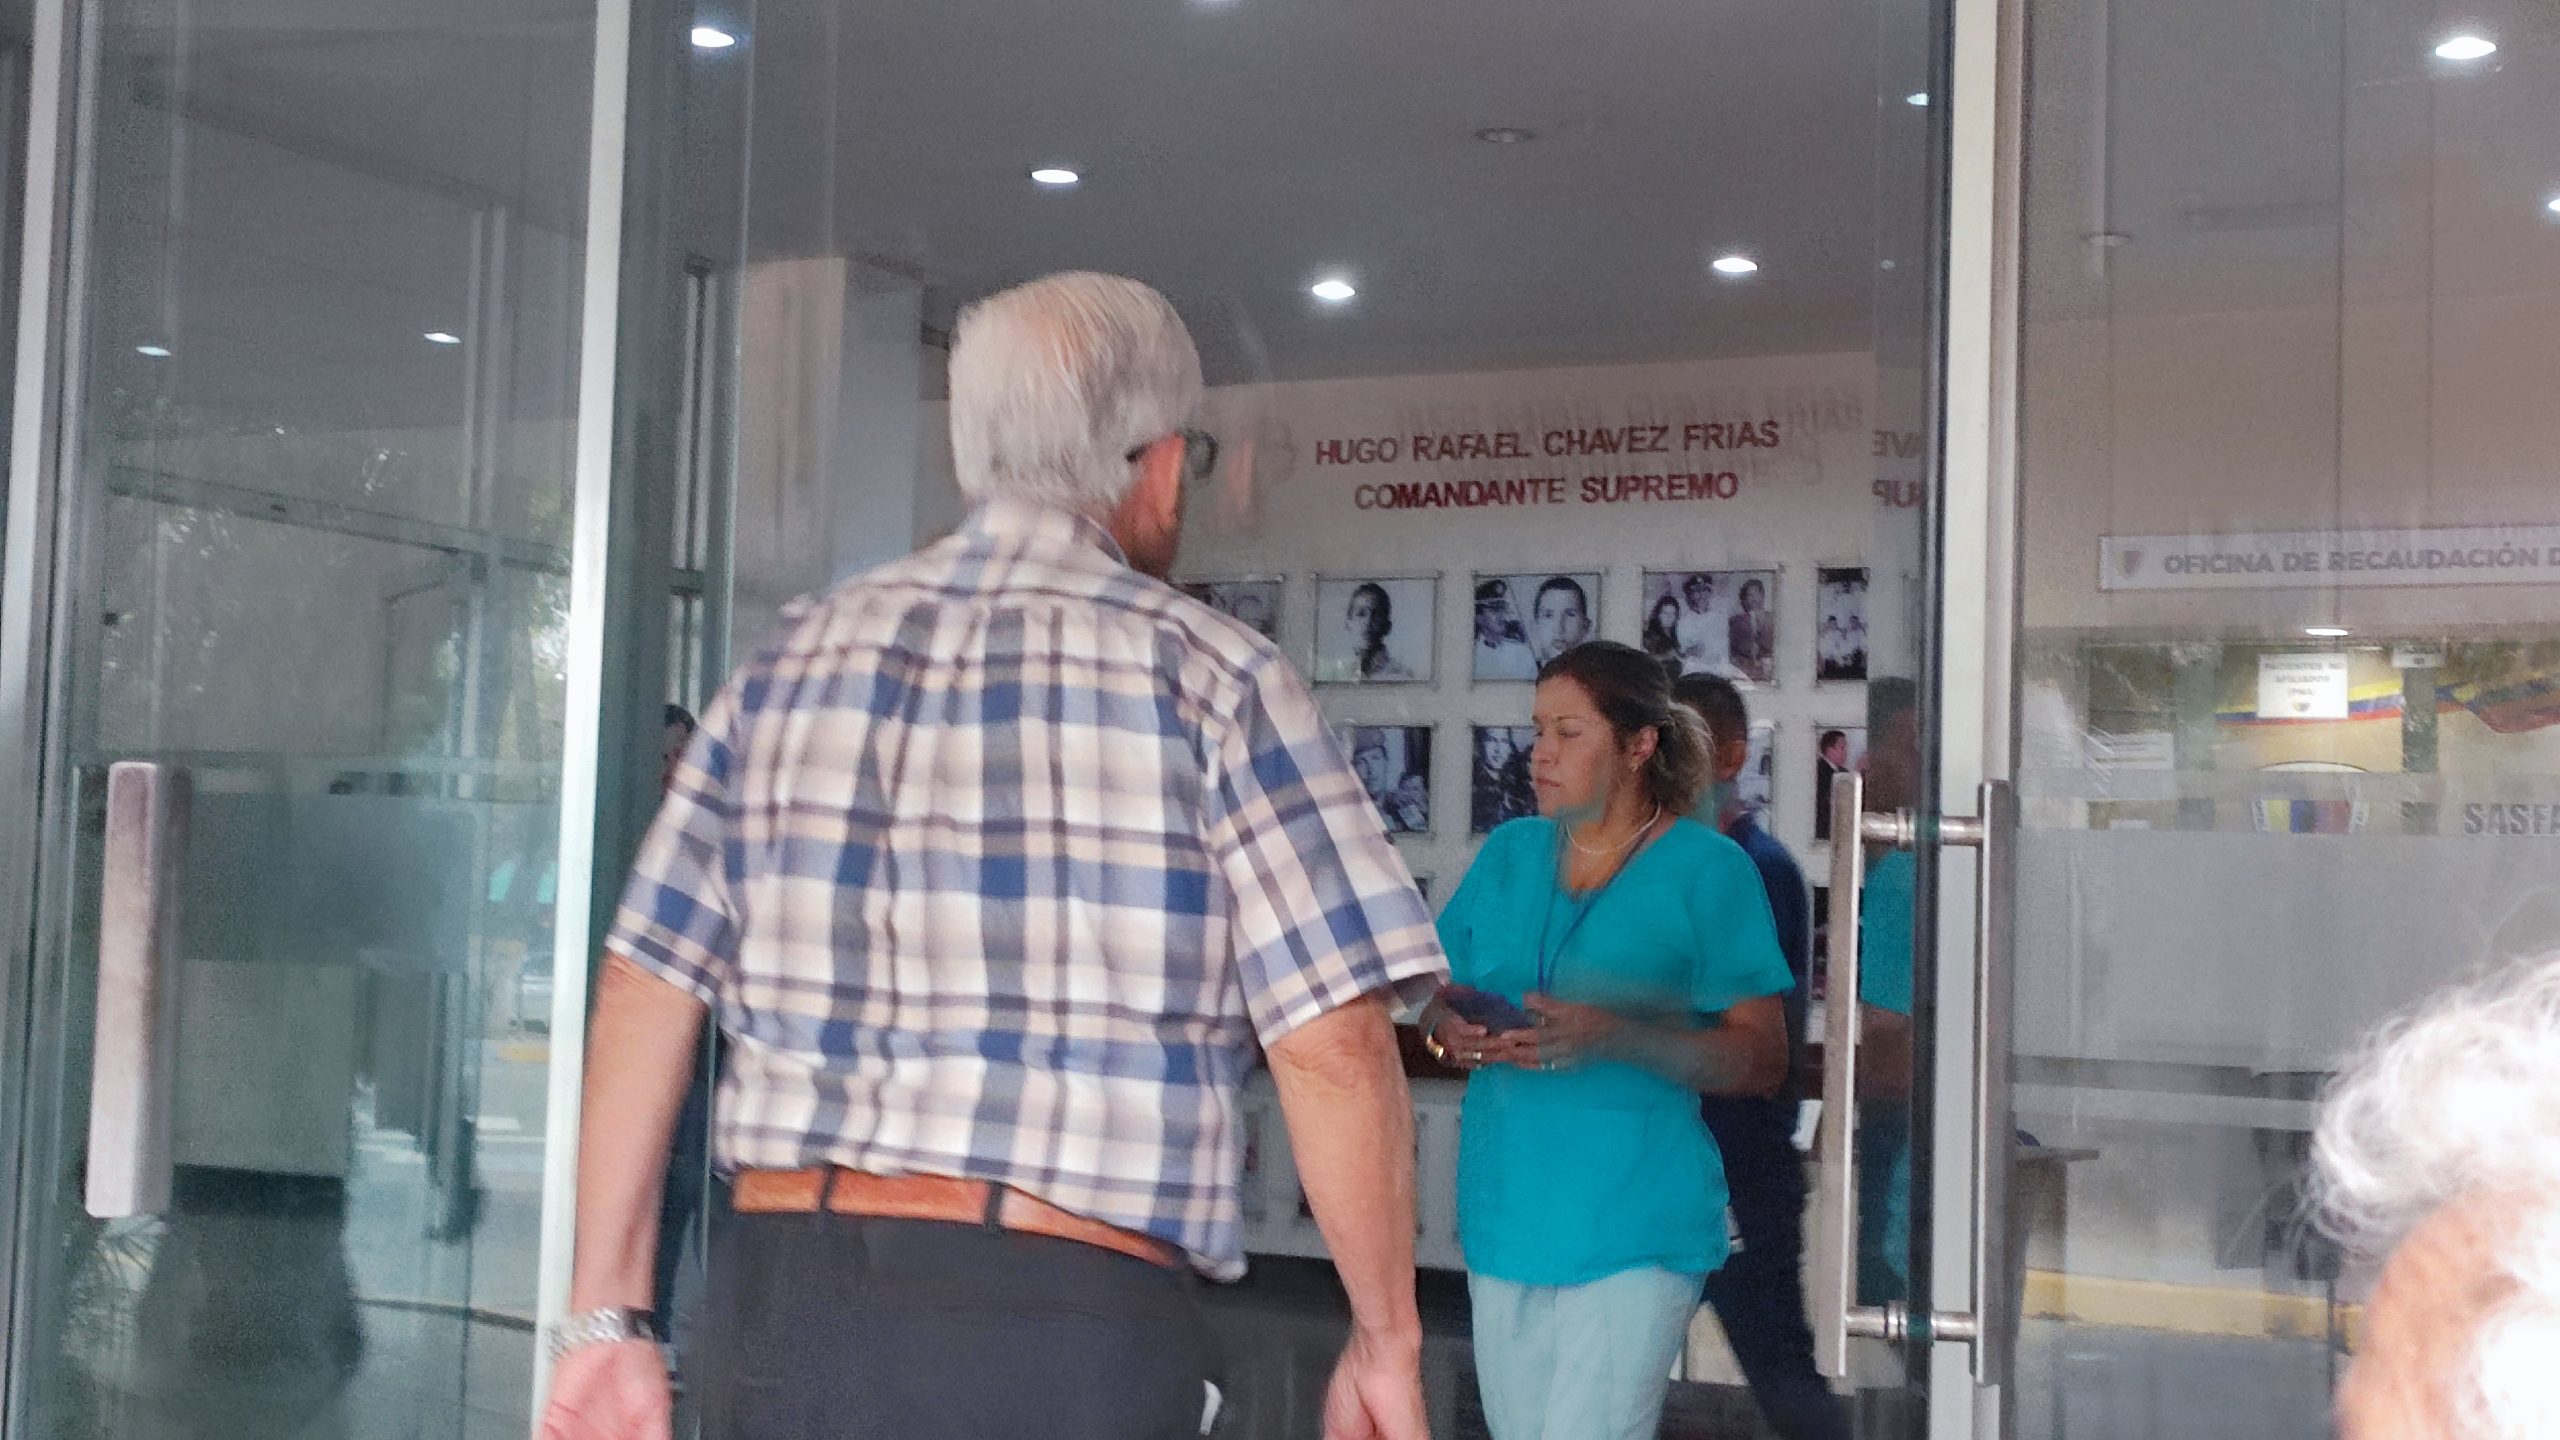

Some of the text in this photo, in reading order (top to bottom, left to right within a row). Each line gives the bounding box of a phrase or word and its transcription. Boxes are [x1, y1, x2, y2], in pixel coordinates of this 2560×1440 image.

[1315, 420, 1780, 465] HUGO RAFAEL CHAVEZ FRIAS
[1354, 471, 1740, 510] COMANDANTE SUPREMO
[2163, 552, 2275, 574] OFICINA
[2282, 551, 2320, 572] DE
[2327, 541, 2540, 572] RECAUDACIÓN
